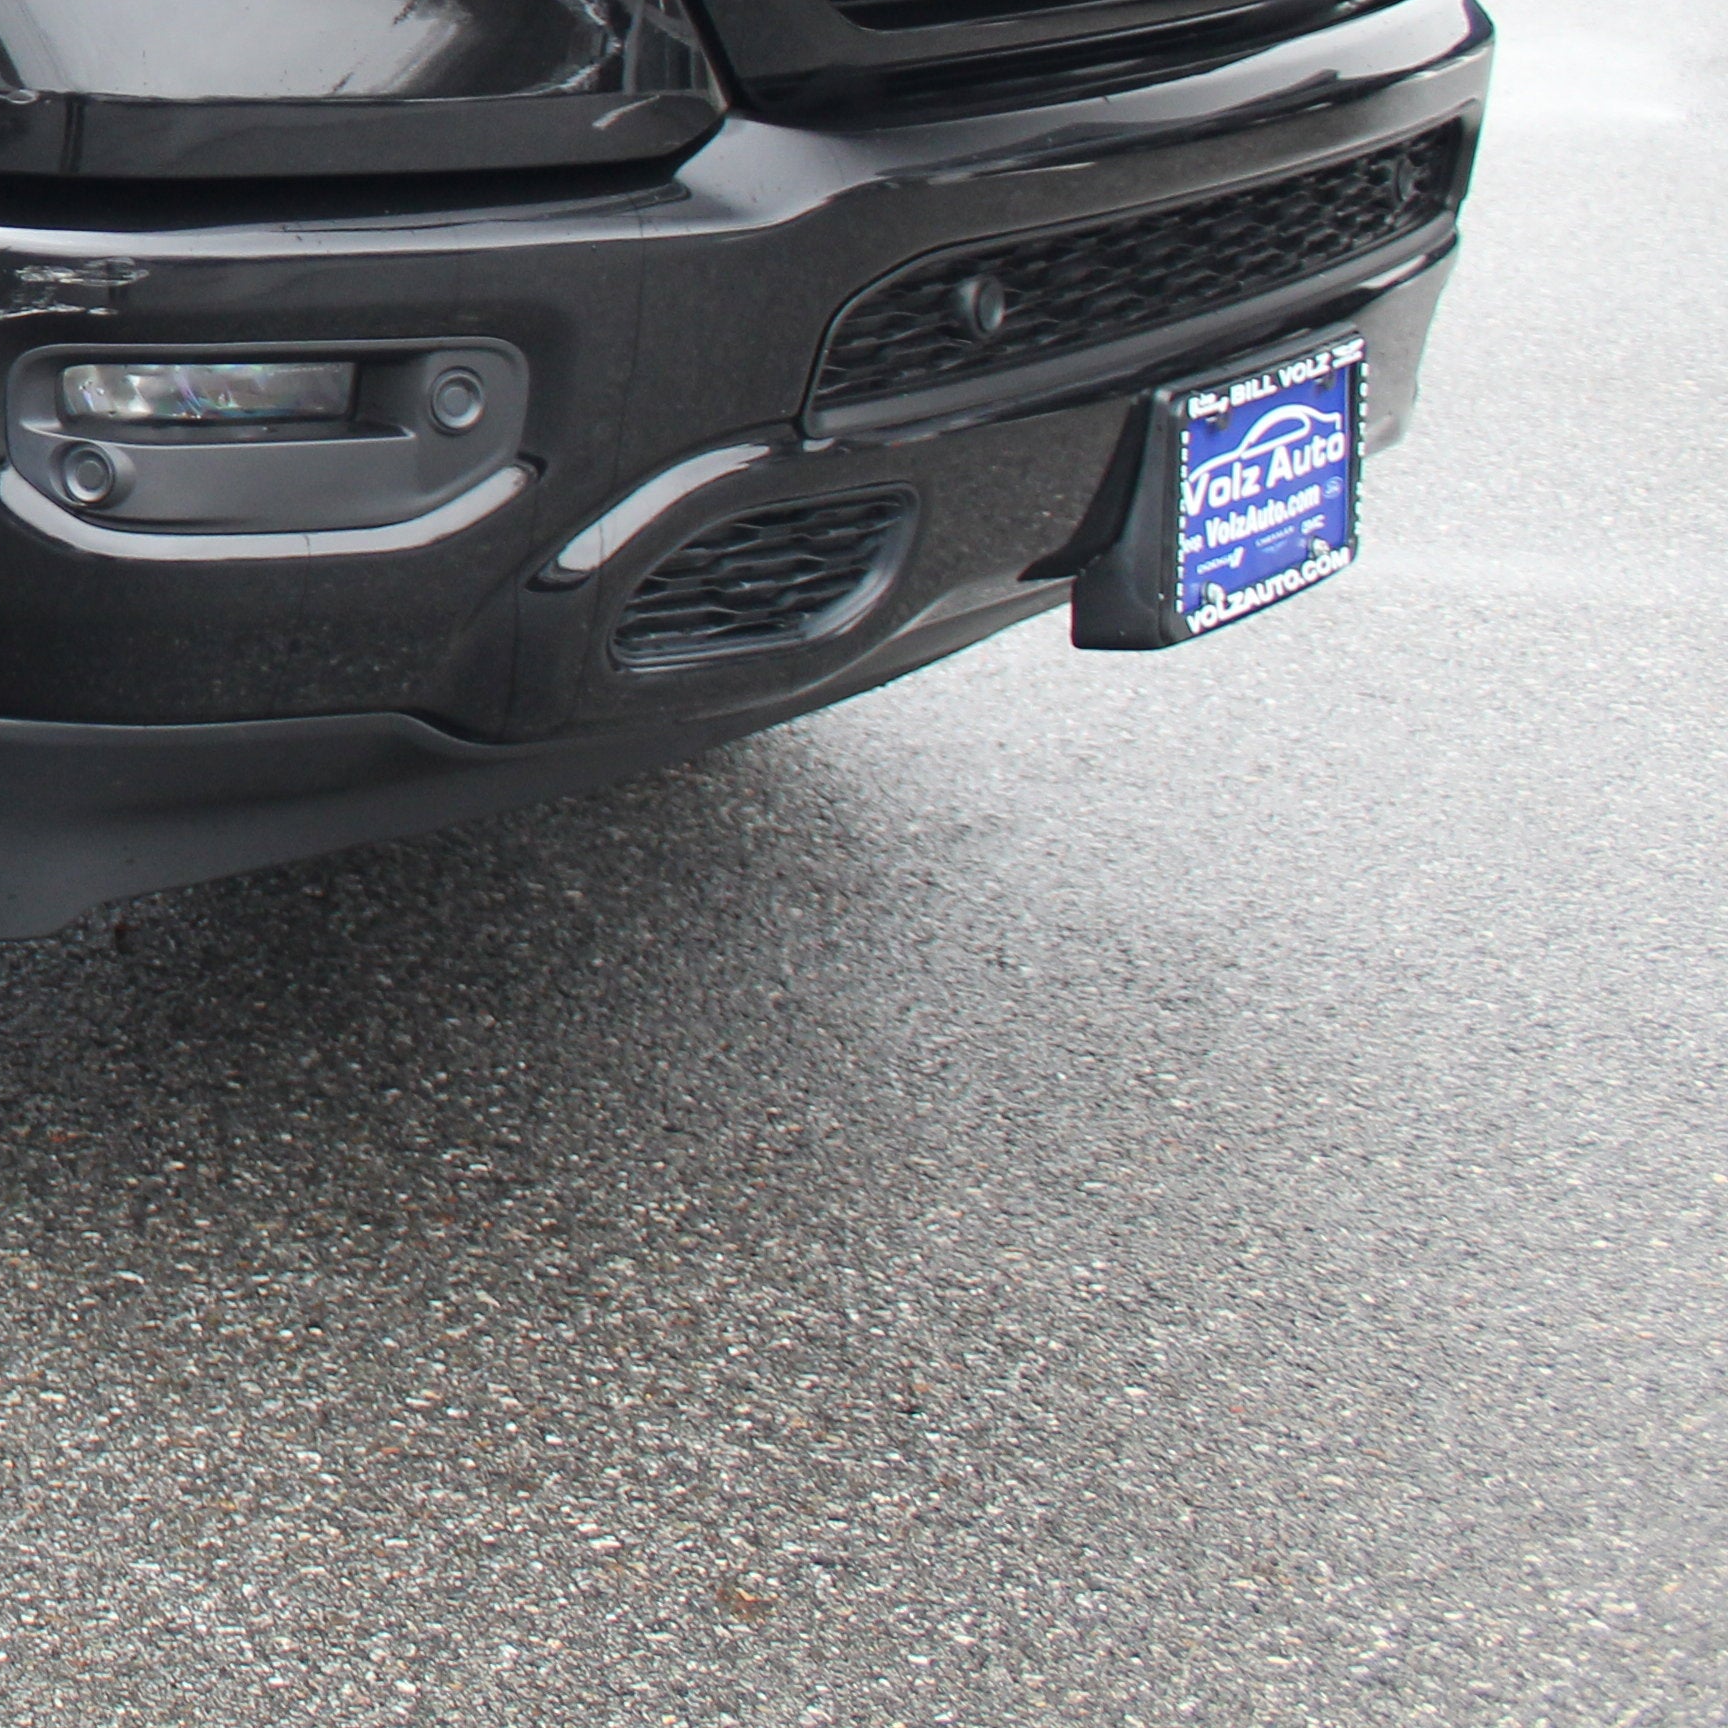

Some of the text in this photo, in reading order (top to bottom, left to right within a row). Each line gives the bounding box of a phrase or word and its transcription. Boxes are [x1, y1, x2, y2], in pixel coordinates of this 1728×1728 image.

[1229, 374, 1279, 407] BILL
[1277, 351, 1332, 388] VOLZ
[1183, 461, 1261, 516] Volz
[1266, 431, 1346, 489] Auto
[1204, 483, 1322, 549] VolzAuto.com
[1186, 546, 1351, 634] VOLZAUTO.COM
